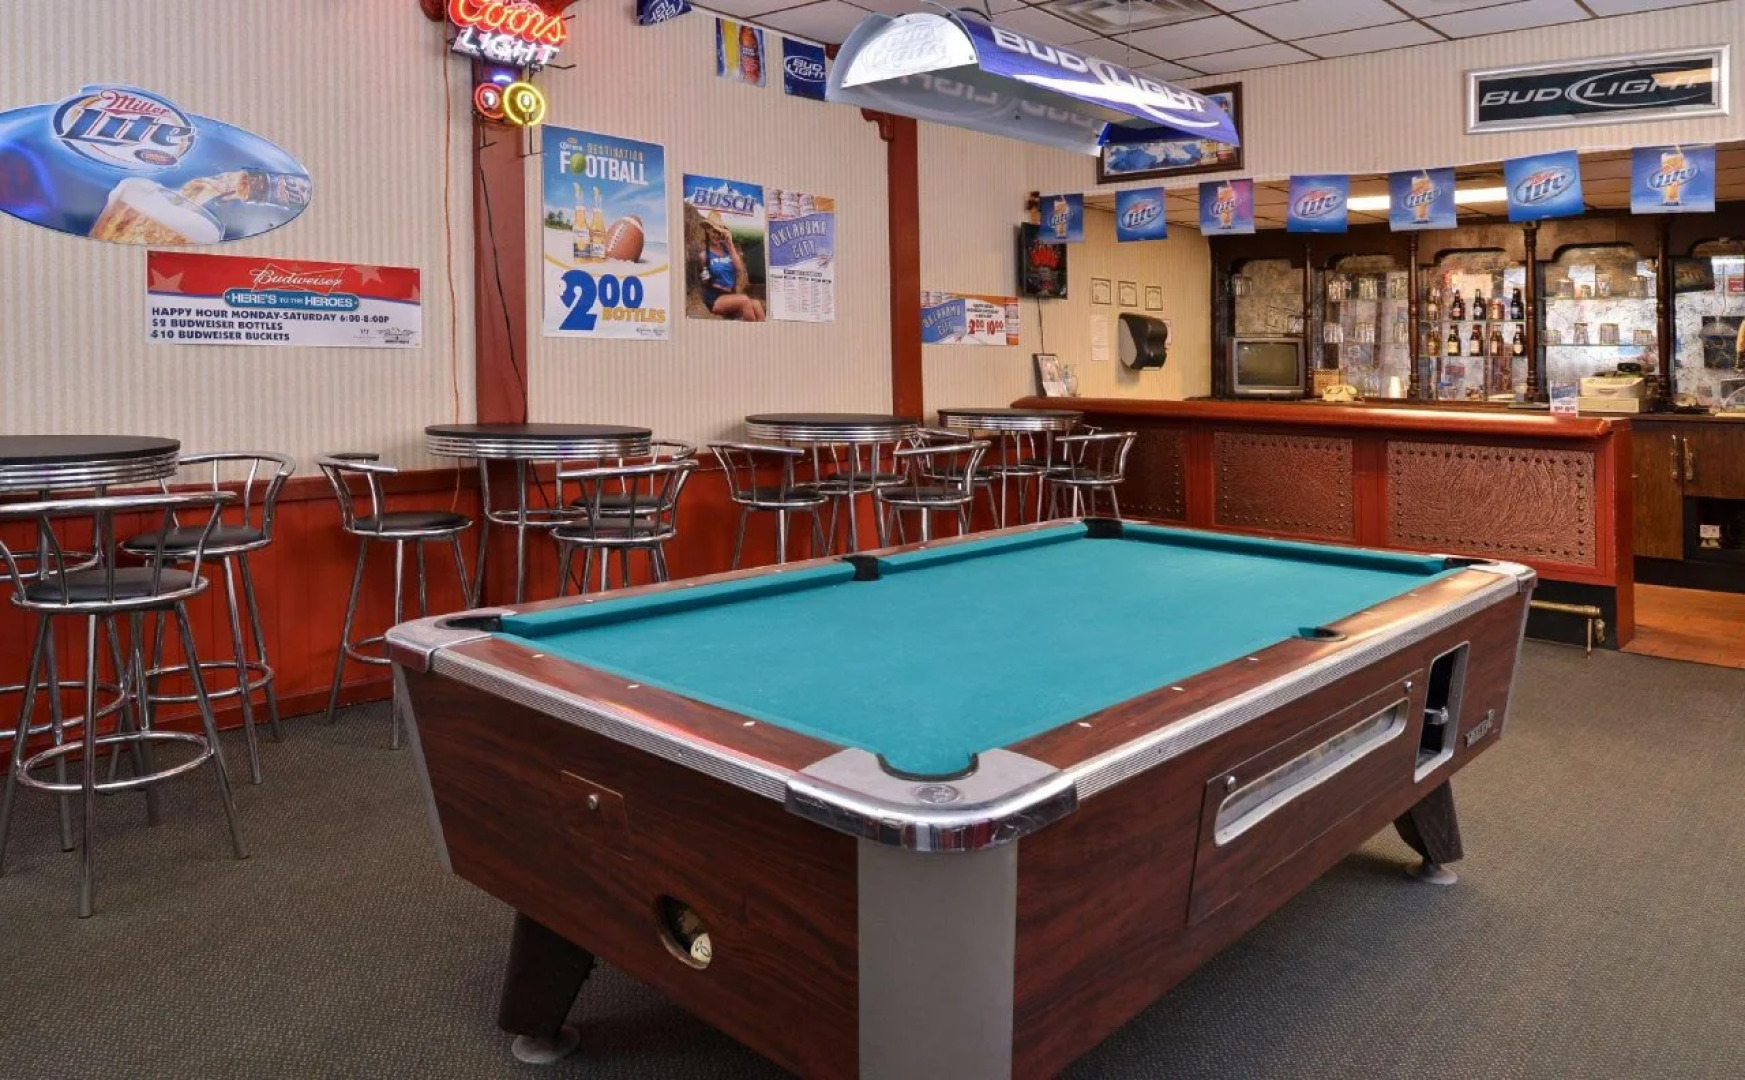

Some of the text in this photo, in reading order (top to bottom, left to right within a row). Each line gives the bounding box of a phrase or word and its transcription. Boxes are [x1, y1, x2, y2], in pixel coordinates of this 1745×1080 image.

[451, 0, 566, 44] Coors
[455, 26, 560, 66] LIGHT
[787, 65, 826, 79] LIGHT
[793, 58, 823, 72] BUD
[989, 25, 1089, 73] BUD
[1105, 63, 1206, 113] LIGHT
[100, 89, 170, 117] Miller
[1480, 87, 1562, 107] BUD
[62, 108, 196, 147] Lite
[1523, 175, 1566, 203] Lite
[693, 188, 755, 213] BUSCH
[1301, 194, 1338, 216] Lite
[792, 240, 816, 259] CITY
[249, 268, 342, 286] Budweiser
[231, 292, 277, 305] HERE'S
[304, 296, 353, 308] HEROES
[152, 307, 192, 316] HAPPY
[196, 308, 228, 319] HOUR
[231, 309, 338, 322] MONDAY-SATURDAY
[602, 307, 666, 324] BOTTLES
[152, 318, 283, 331] $2 BUDWEISER BOTTLES
[151, 329, 290, 341] $10 BUDWEISER BUCKETS
